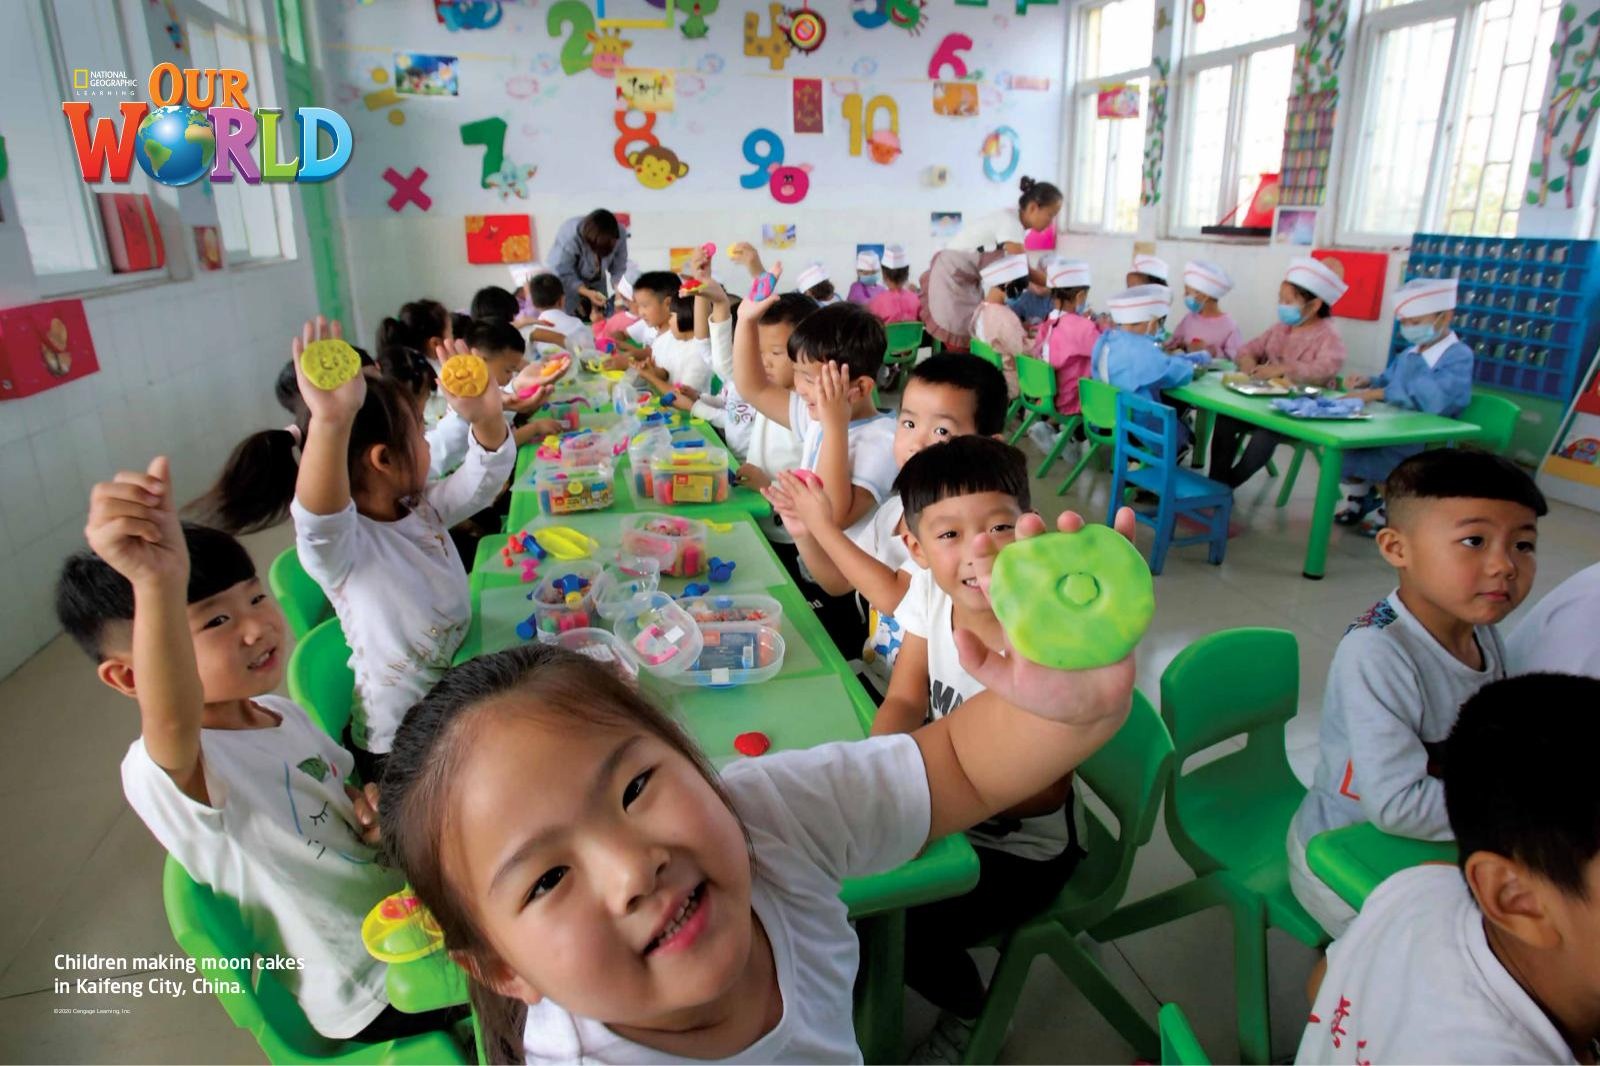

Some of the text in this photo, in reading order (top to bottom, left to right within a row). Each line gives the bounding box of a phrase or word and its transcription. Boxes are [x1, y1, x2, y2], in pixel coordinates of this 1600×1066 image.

[547, 0, 595, 76] 2
[744, 2, 791, 70] 4
[928, 32, 973, 80] 6
[460, 116, 508, 189] 7
[841, 93, 899, 157] 10
[739, 127, 785, 190] 9
